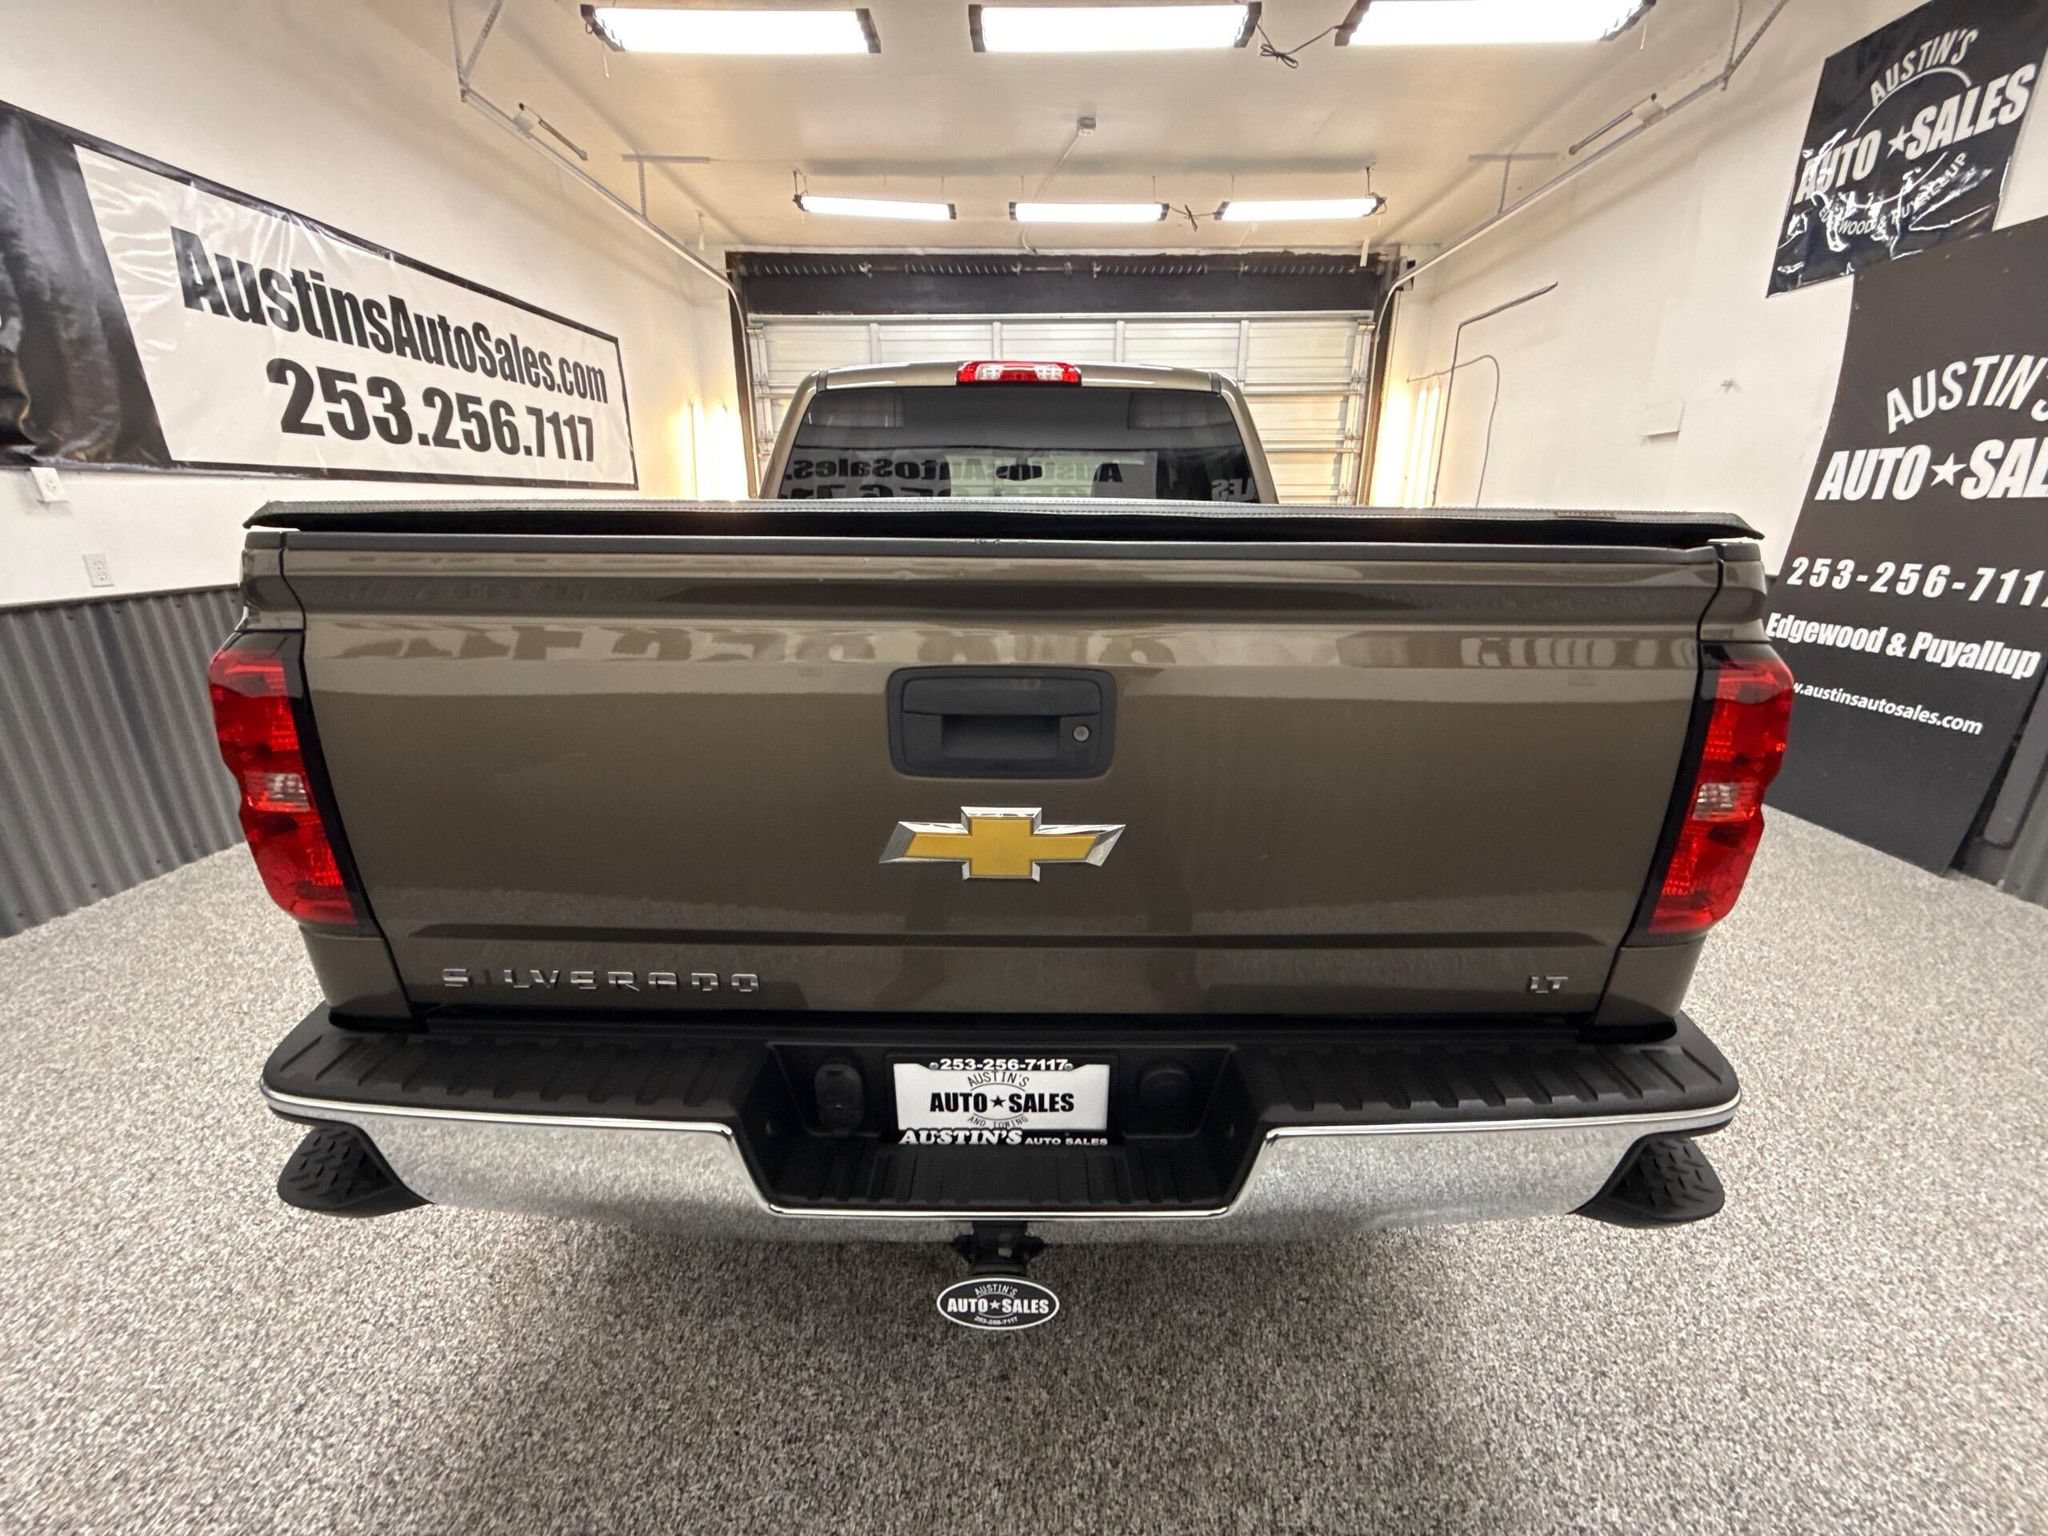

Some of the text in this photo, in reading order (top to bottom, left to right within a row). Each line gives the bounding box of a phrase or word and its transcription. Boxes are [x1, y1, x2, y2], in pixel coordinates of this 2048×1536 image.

[1871, 28, 1978, 106] AUSTIN'S
[1794, 63, 2037, 204] AUTO SALES
[171, 226, 608, 403] AustinsAutoSales.com
[1886, 354, 2048, 433] AUSTIN
[266, 358, 594, 462] 253.256.7117
[1814, 444, 1931, 501] AUTO
[1787, 556, 2048, 608] 253-256-711
[1766, 612, 2042, 680] Edgewood & Puyallup
[442, 967, 759, 993] SILVERADO
[1530, 976, 1569, 994] LT
[940, 1058, 1068, 1071] 253-256-7117
[967, 1070, 1030, 1088] AUSTIN'S
[929, 1092, 1074, 1113] AUTO SALES
[967, 1116, 986, 1127] AND
[898, 1129, 1108, 1146] AUSTIN'S AUTO SALES
[974, 1284, 1018, 1296] AUSTIN'S
[947, 1298, 1049, 1313] AUTO SALES
